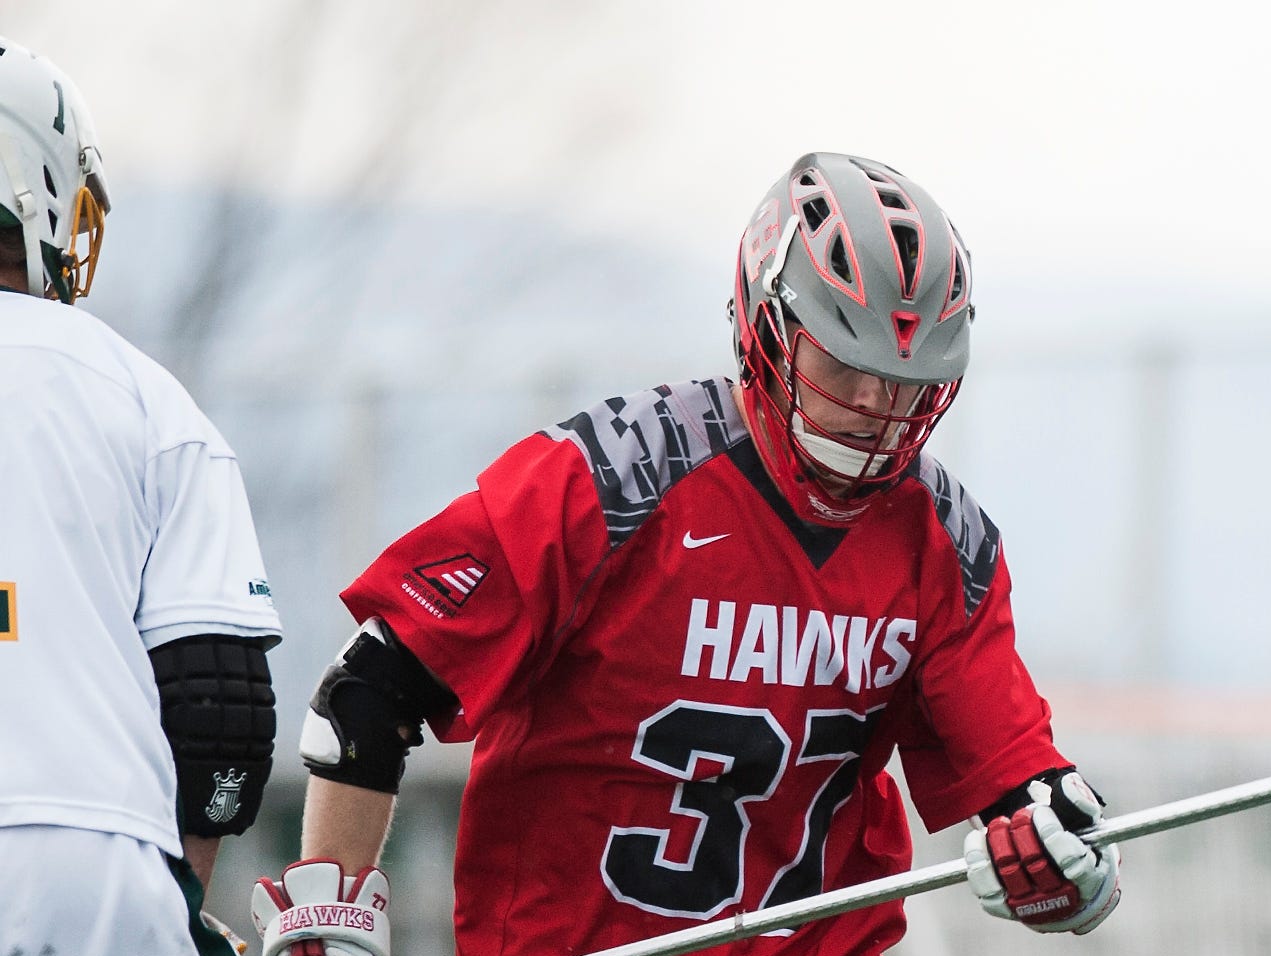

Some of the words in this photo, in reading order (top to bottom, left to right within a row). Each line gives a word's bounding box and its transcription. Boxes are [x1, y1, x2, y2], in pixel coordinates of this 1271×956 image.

[681, 598, 917, 694] HAWKS
[600, 699, 888, 938] 37
[279, 905, 374, 935] HAWKS
[1015, 894, 1070, 917] HARTFORD
